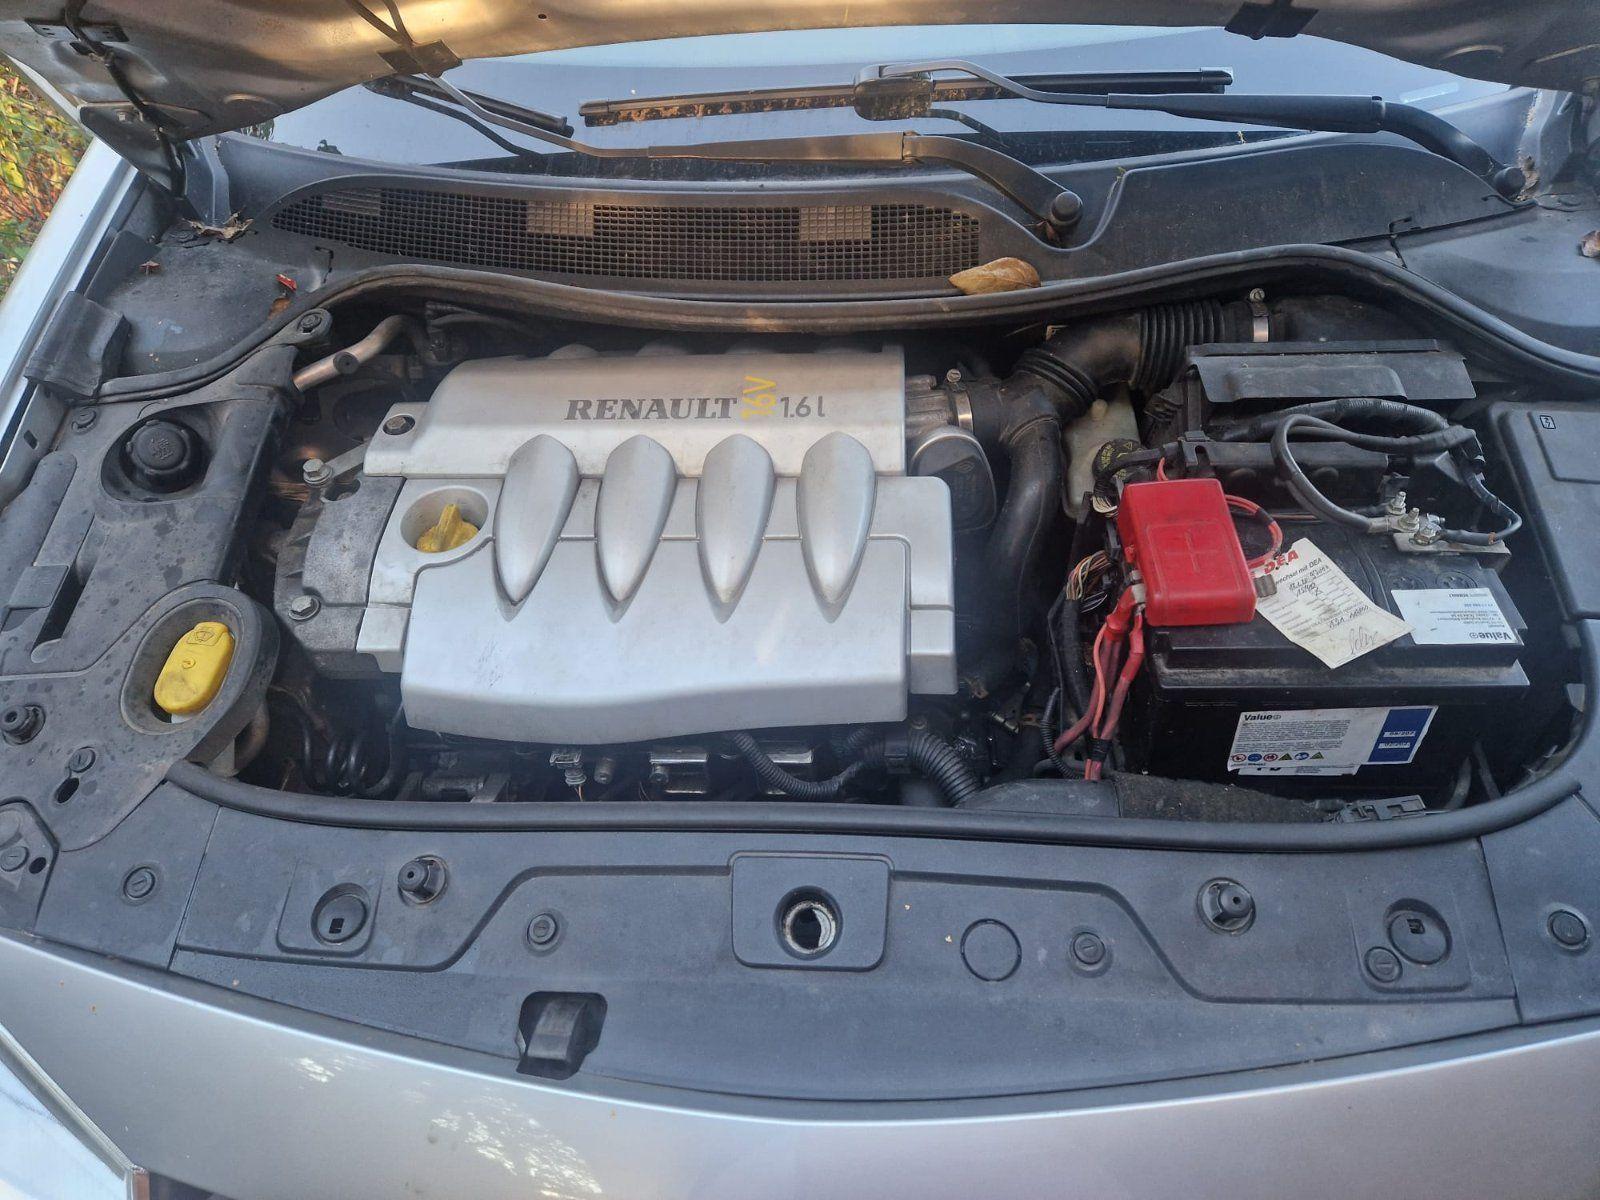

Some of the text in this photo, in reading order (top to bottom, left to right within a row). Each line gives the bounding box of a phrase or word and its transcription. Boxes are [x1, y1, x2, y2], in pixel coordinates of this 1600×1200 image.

[741, 375, 777, 418] 16V
[564, 397, 737, 420] RENAULT
[1264, 550, 1299, 574] DEA
[1309, 557, 1322, 569] DEA
[1478, 631, 1512, 641] Value
[1244, 713, 1273, 721] Value
